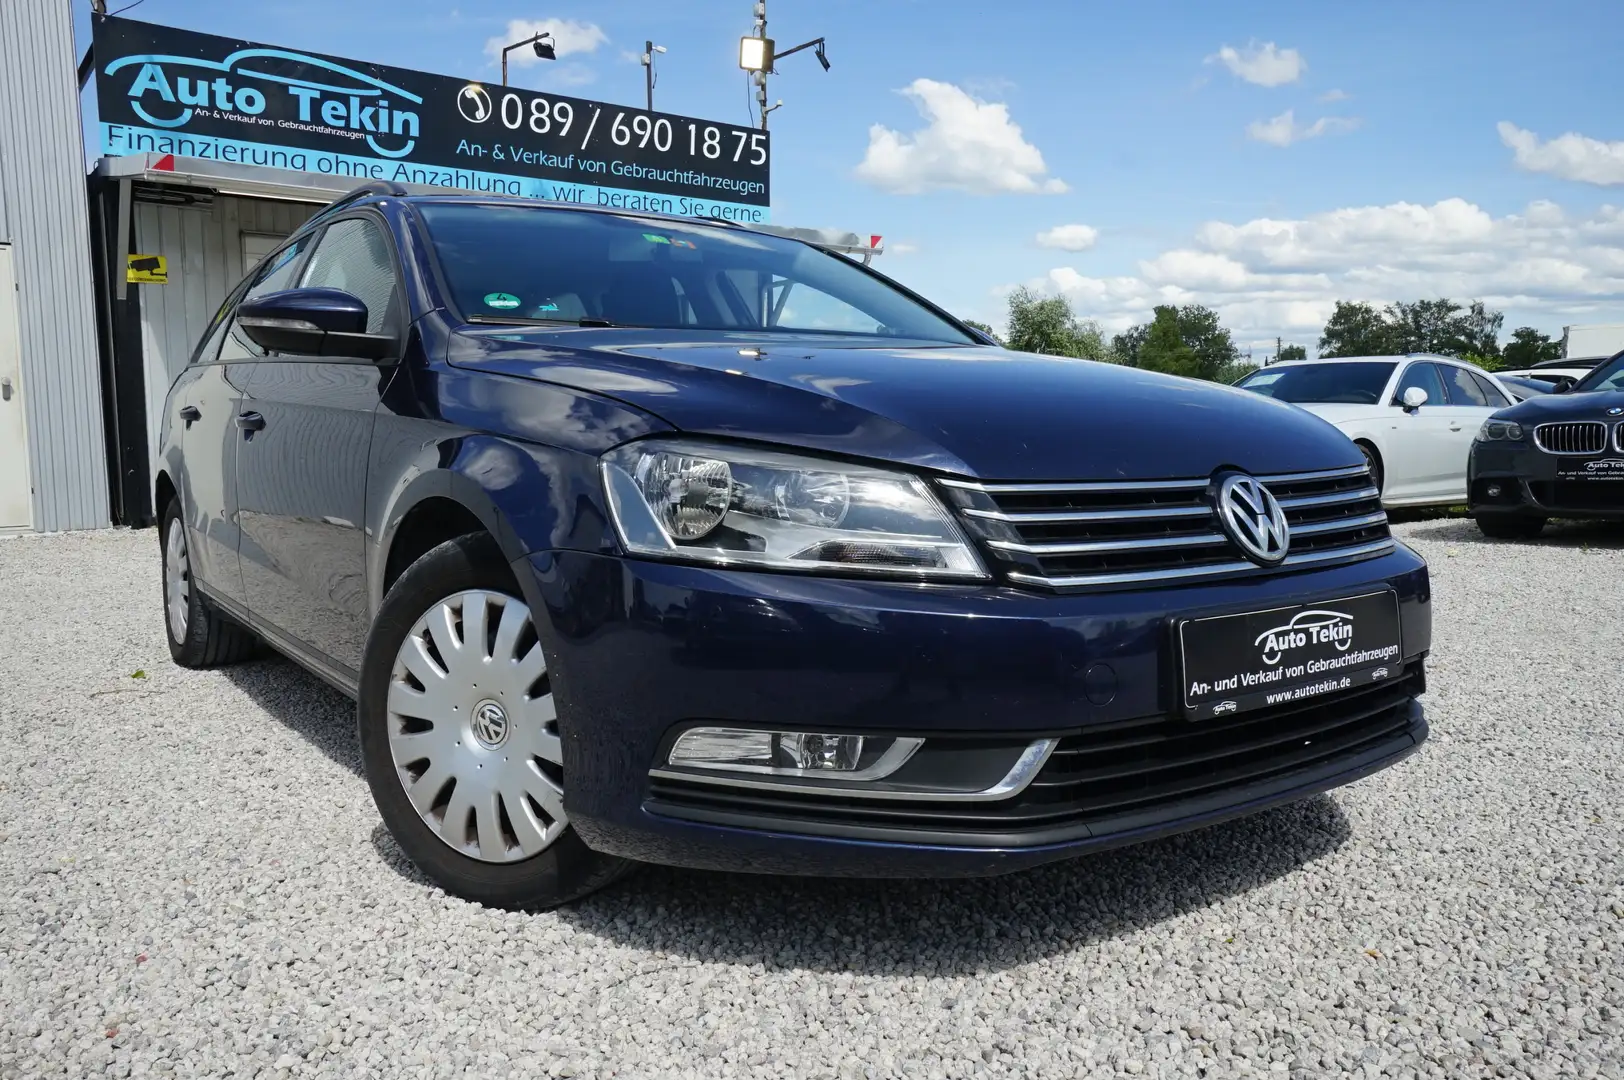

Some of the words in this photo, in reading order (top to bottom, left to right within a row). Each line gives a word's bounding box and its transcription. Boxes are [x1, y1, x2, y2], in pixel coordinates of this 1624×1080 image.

[128, 63, 266, 114] Auto
[289, 86, 420, 138] Tekin
[195, 107, 212, 118] An-
[213, 110, 221, 119] &
[222, 112, 256, 124] Verkauf
[258, 118, 274, 127] von
[278, 120, 365, 140] Gebrauchtfahrzeugen
[501, 94, 574, 137] 089
[581, 108, 601, 150] /
[611, 112, 673, 152] 690
[688, 124, 721, 159] 18
[731, 131, 767, 165] 75
[108, 125, 307, 171] Finanzierung
[317, 155, 384, 180] ohne
[392, 163, 521, 196] Anzahlung
[553, 184, 586, 203] wir
[597, 188, 672, 213] beraten
[680, 197, 705, 217] Sie
[456, 139, 488, 157] An-
[492, 144, 505, 161] &
[510, 146, 575, 169] Verkauf
[577, 159, 606, 174] von
[611, 161, 766, 195] Gebrauchtfahrzeugen
[1264, 632, 1306, 653] Auto
[1309, 623, 1352, 644] Tekin
[1190, 682, 1212, 696] An-
[1214, 675, 1238, 691] und
[1241, 666, 1283, 686] Verkauf
[1285, 665, 1304, 678] von
[1307, 645, 1398, 674] Gebrauchtfahrzeugen
[1266, 677, 1351, 704] www.autotekin.de
